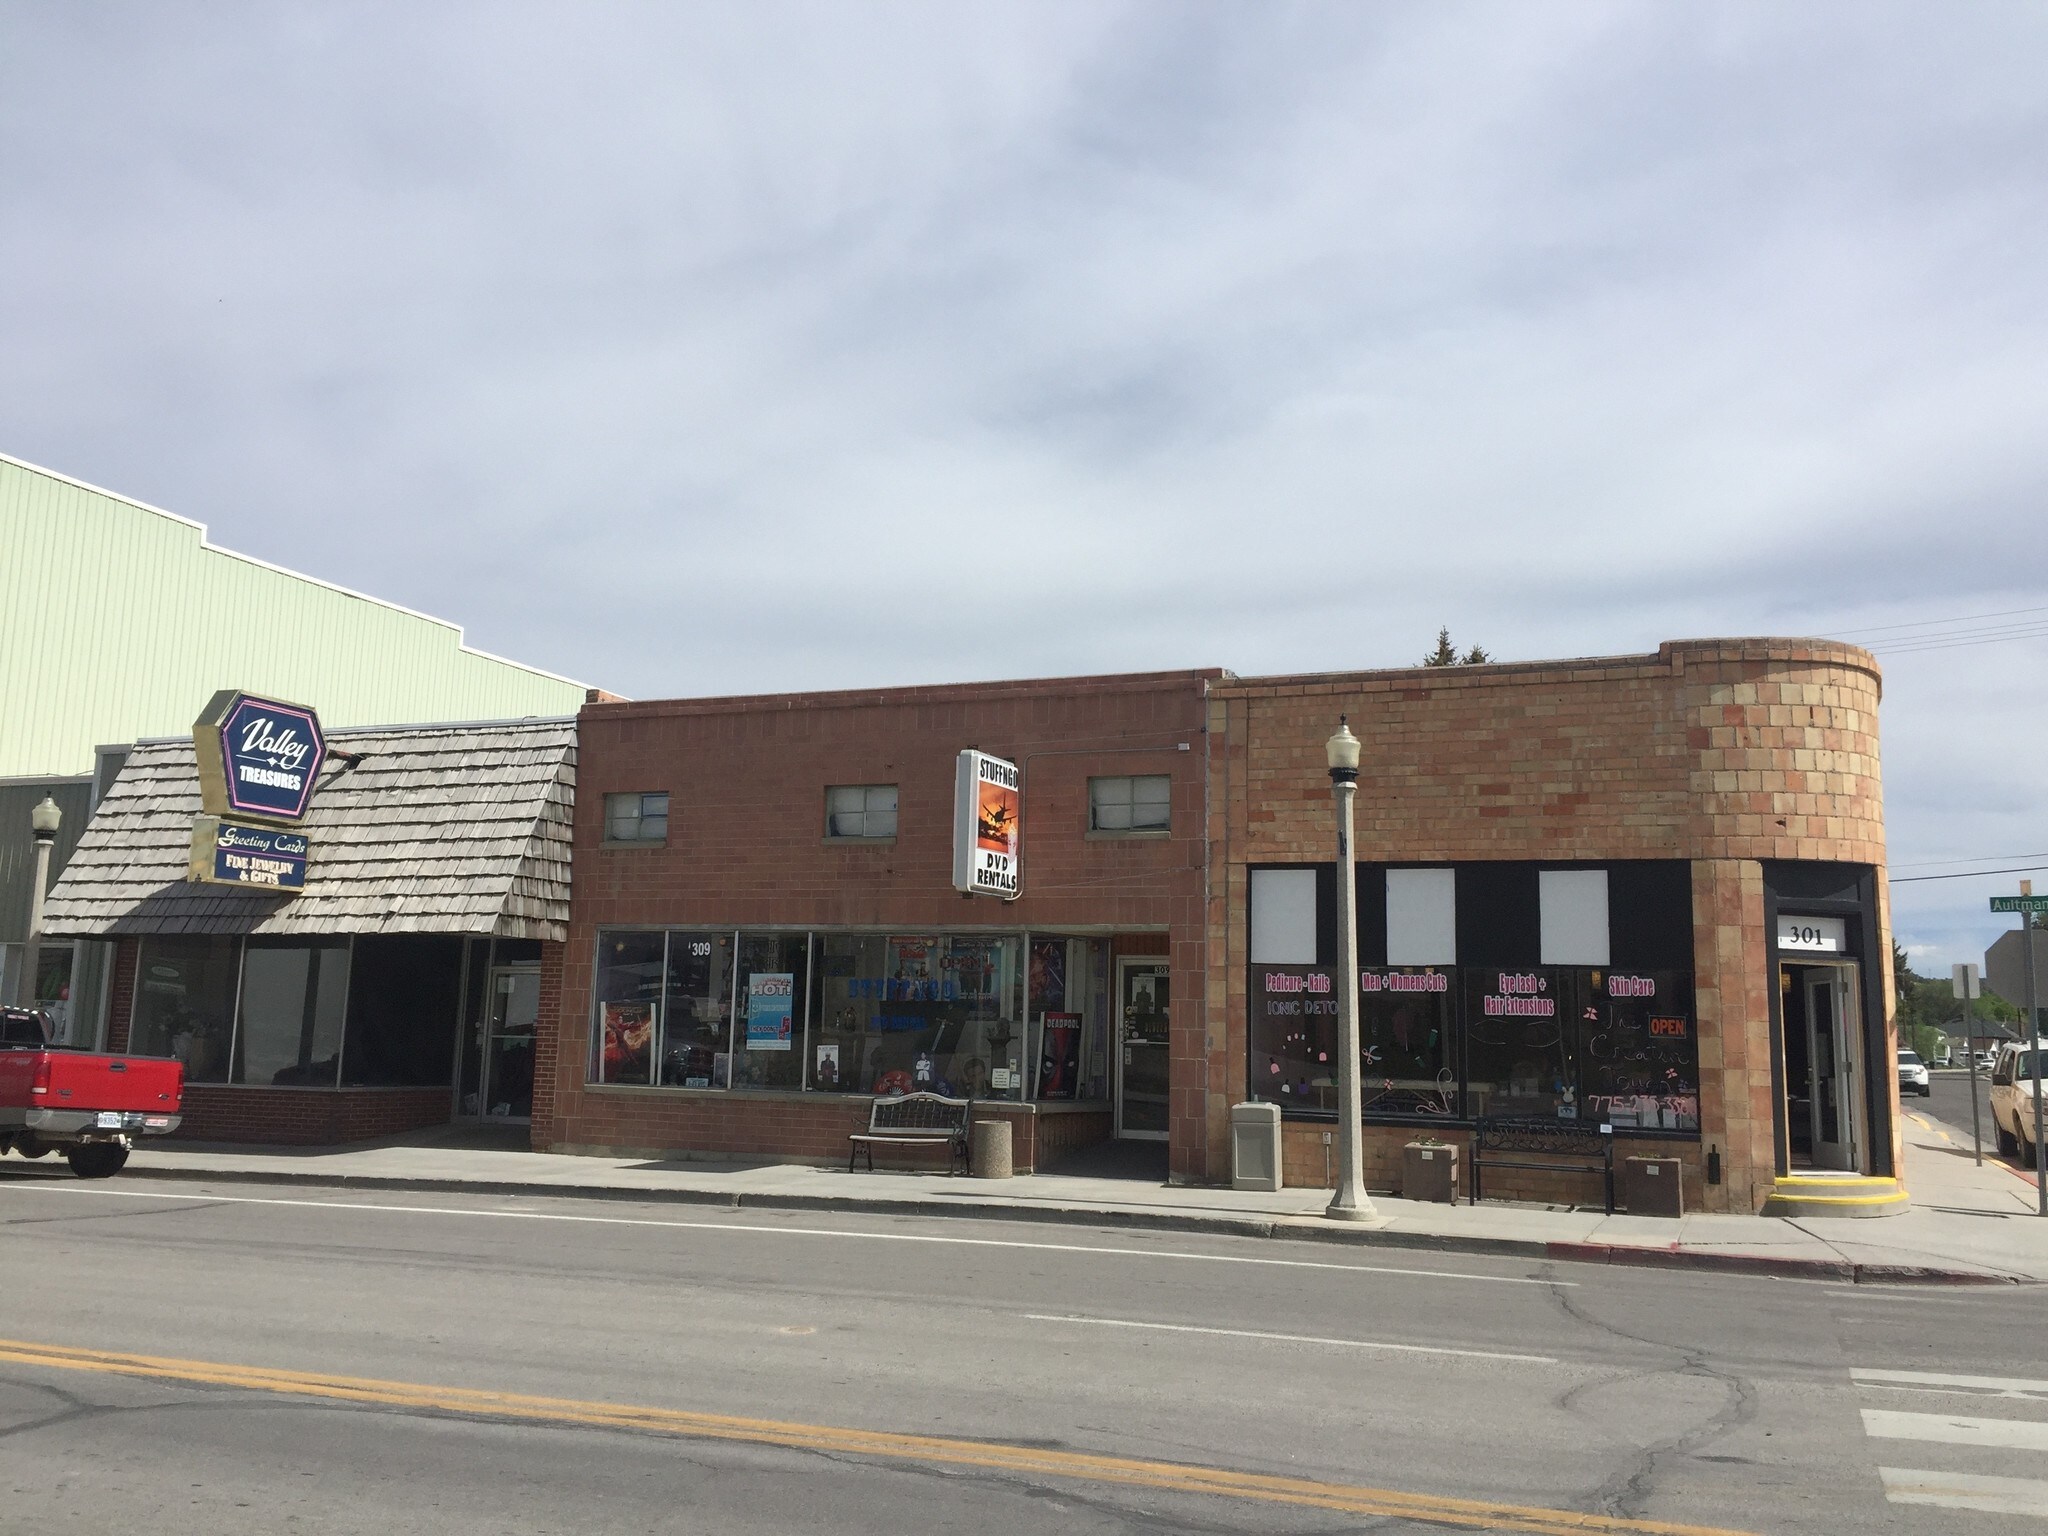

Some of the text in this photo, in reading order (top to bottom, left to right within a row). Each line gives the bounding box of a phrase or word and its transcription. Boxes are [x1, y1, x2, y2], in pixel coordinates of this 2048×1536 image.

[242, 718, 309, 770] Valley
[240, 765, 301, 791] TREASURES
[980, 758, 1018, 788] STUFFNGO
[218, 827, 305, 854] Greeting Cards
[226, 853, 249, 870] FINE
[987, 853, 1008, 870] DVD
[239, 871, 279, 885] & GIFTS
[977, 868, 1016, 890] RENTALS
[1993, 899, 2048, 911] Aultman
[1790, 926, 1823, 946] 301
[692, 942, 711, 956] 309
[751, 985, 791, 996] HOT!
[1266, 973, 1302, 992] Pedicure
[1307, 973, 1330, 993] Nails
[1362, 973, 1381, 991] Men
[1389, 972, 1426, 991] Womens
[1426, 972, 1447, 992] Cuts
[1499, 973, 1516, 994] Eye
[1515, 973, 1537, 993] lash
[1609, 975, 1655, 996] Skin Care
[1267, 1001, 1338, 1015] IONIC DETO
[1485, 996, 1554, 1016] Hair Extensions
[1047, 1019, 1079, 1028] DEADPOOL
[1651, 1019, 1685, 1035] OPEN
